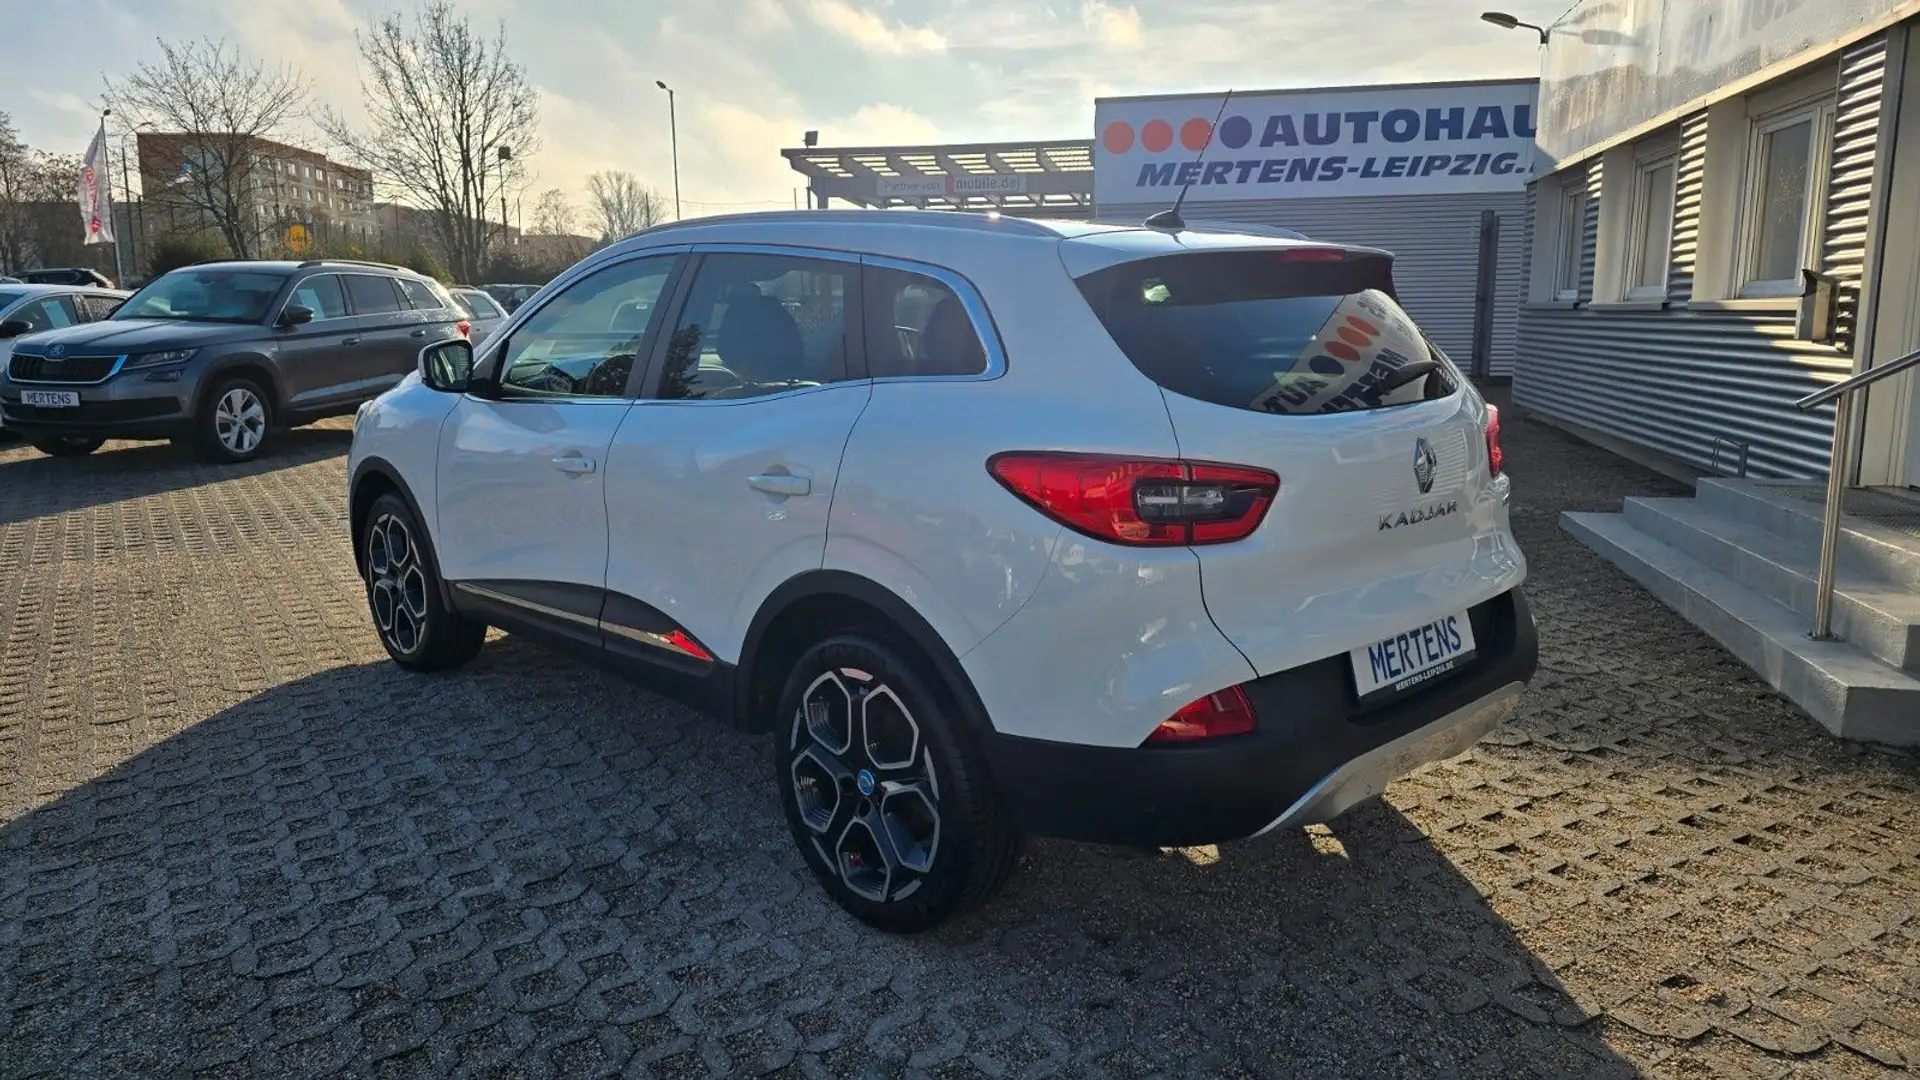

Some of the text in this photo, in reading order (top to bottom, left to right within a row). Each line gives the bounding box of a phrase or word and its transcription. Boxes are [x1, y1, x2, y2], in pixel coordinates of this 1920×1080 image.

[955, 175, 1020, 191] mobile.de
[1136, 152, 1535, 187] MERTENS-LEIPZIG.
[27, 392, 72, 405] MERTENS
[1379, 500, 1460, 531] KADJAR
[1368, 616, 1462, 684] MERTENS
